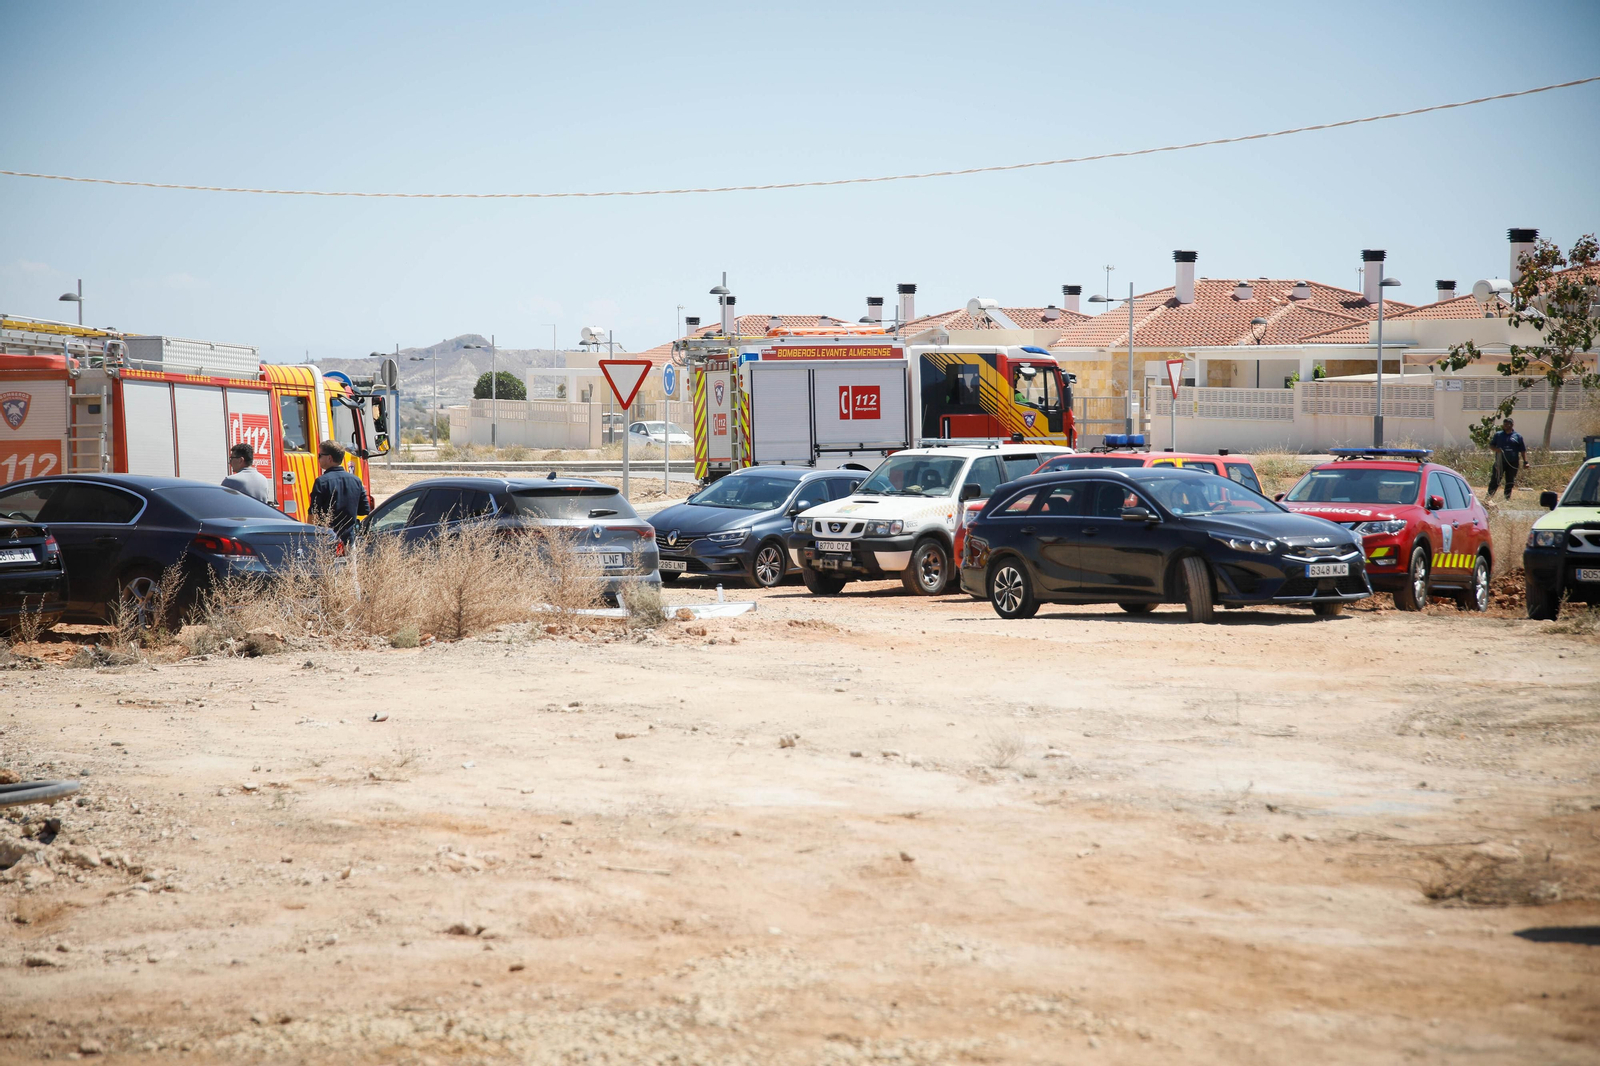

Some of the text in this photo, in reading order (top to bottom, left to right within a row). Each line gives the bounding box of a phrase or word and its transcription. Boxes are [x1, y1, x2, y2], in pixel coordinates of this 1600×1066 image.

[777, 348, 816, 358] BOMBEROS
[816, 348, 848, 357] LEVANTE
[848, 347, 892, 357] ALMERIENSE
[126, 369, 165, 379] BOMBEROS
[185, 374, 211, 383] LEVANTE
[855, 394, 877, 406] 112
[243, 426, 268, 455] 112
[1, 453, 58, 482] 112
[819, 541, 850, 551] 8770 CYZ
[0, 550, 16, 561] 816
[603, 554, 620, 565] LNF
[660, 560, 686, 570] 295 LNF
[1310, 565, 1347, 576] 6348 MJC
